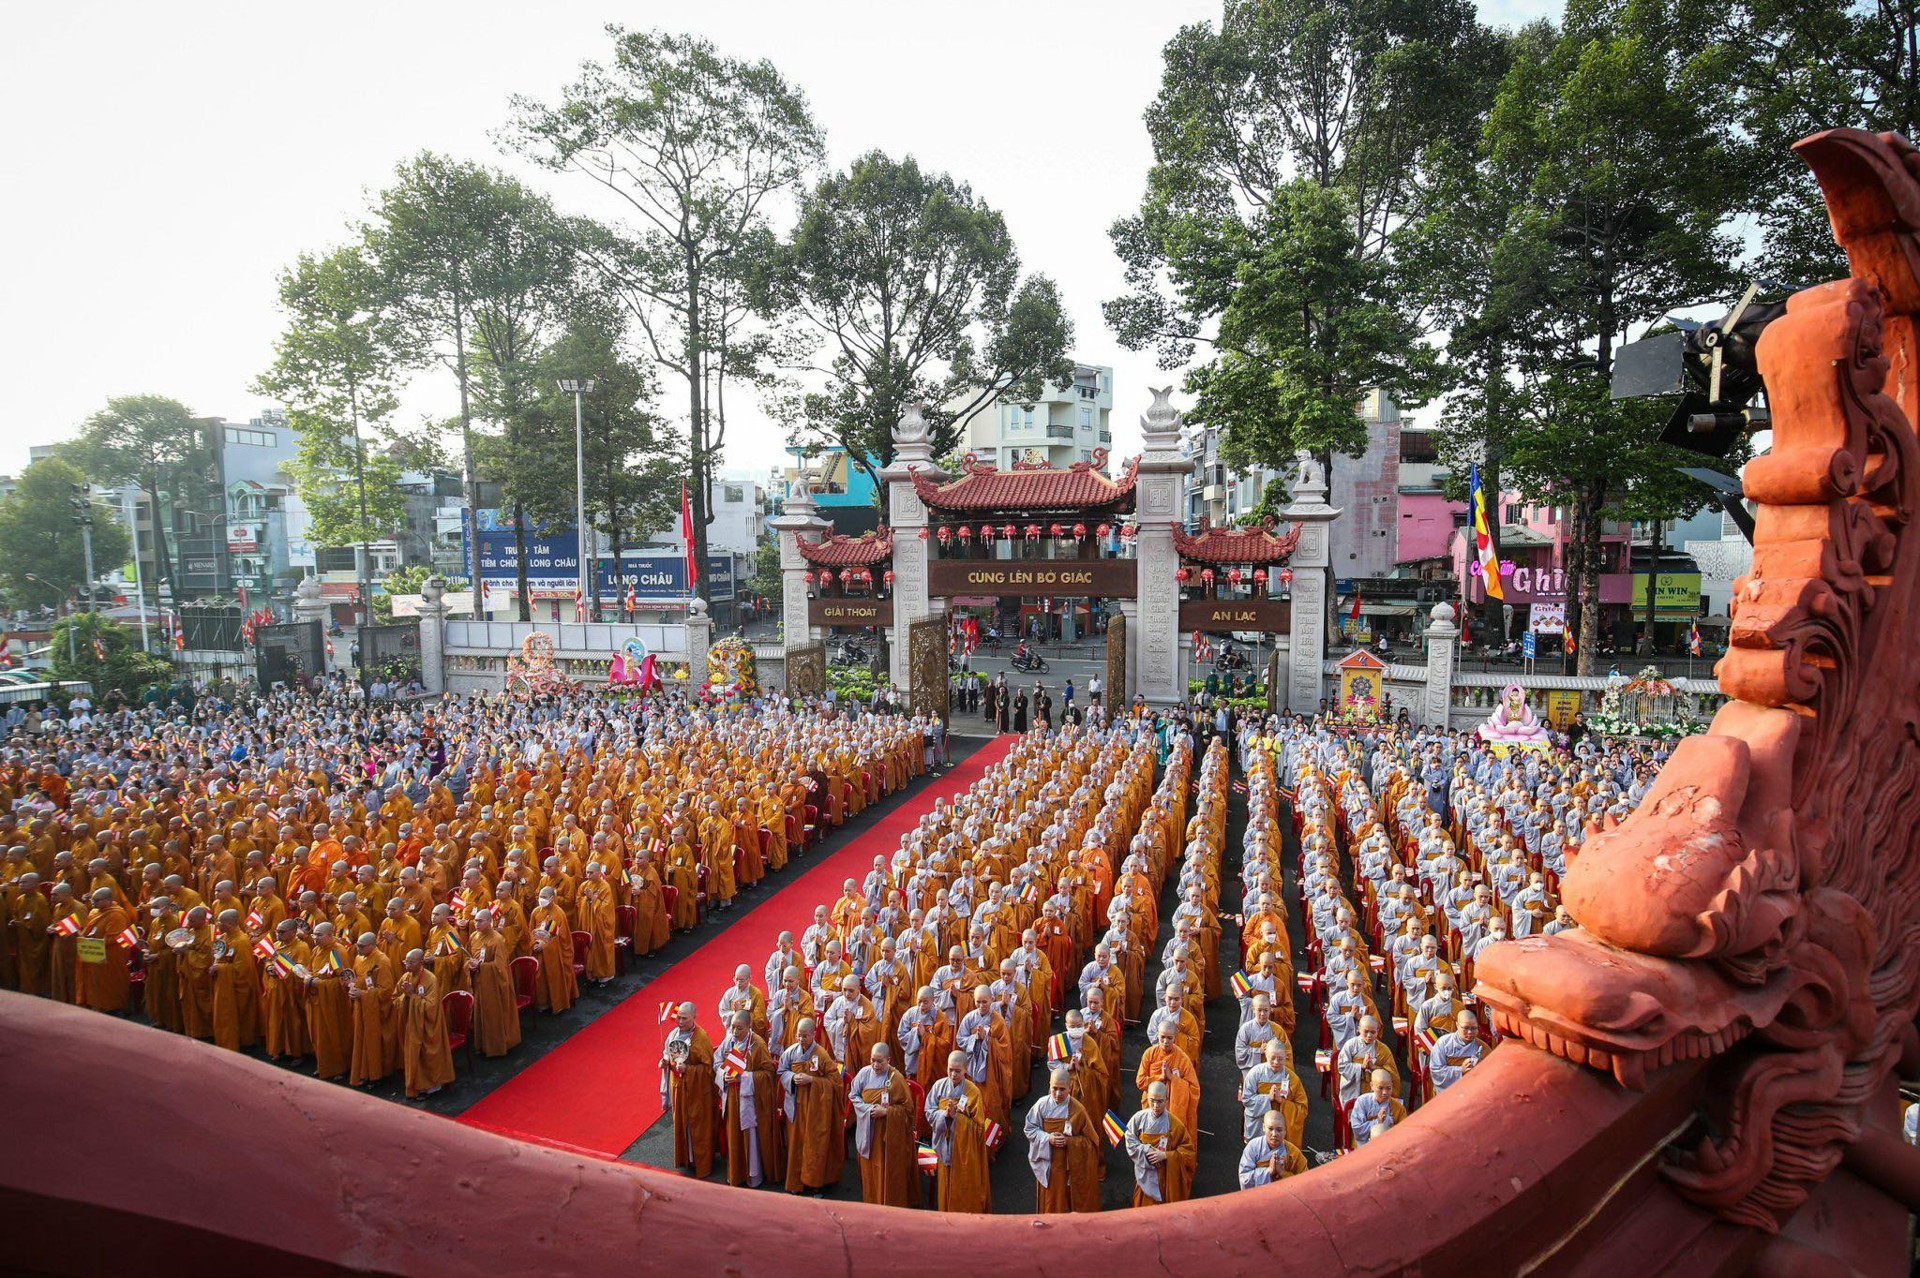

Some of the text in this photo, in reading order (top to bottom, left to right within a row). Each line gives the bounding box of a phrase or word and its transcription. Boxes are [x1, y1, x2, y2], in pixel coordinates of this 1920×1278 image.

[504, 545, 550, 555] TRU TÂM
[481, 557, 496, 568] TIÊM
[530, 559, 550, 568] LONG
[555, 557, 577, 568] CHÂU
[640, 571, 673, 585] CHÂU
[967, 569, 1092, 583] CÙNG LÊN BỜ GIÁC
[501, 579, 514, 587] cho
[538, 579, 546, 587] và
[546, 579, 566, 589] người
[566, 579, 577, 587] lớn
[1668, 587, 1688, 595] WIN
[824, 605, 877, 617] GIẢI THOÁT
[1212, 611, 1257, 623] AN LẠC
